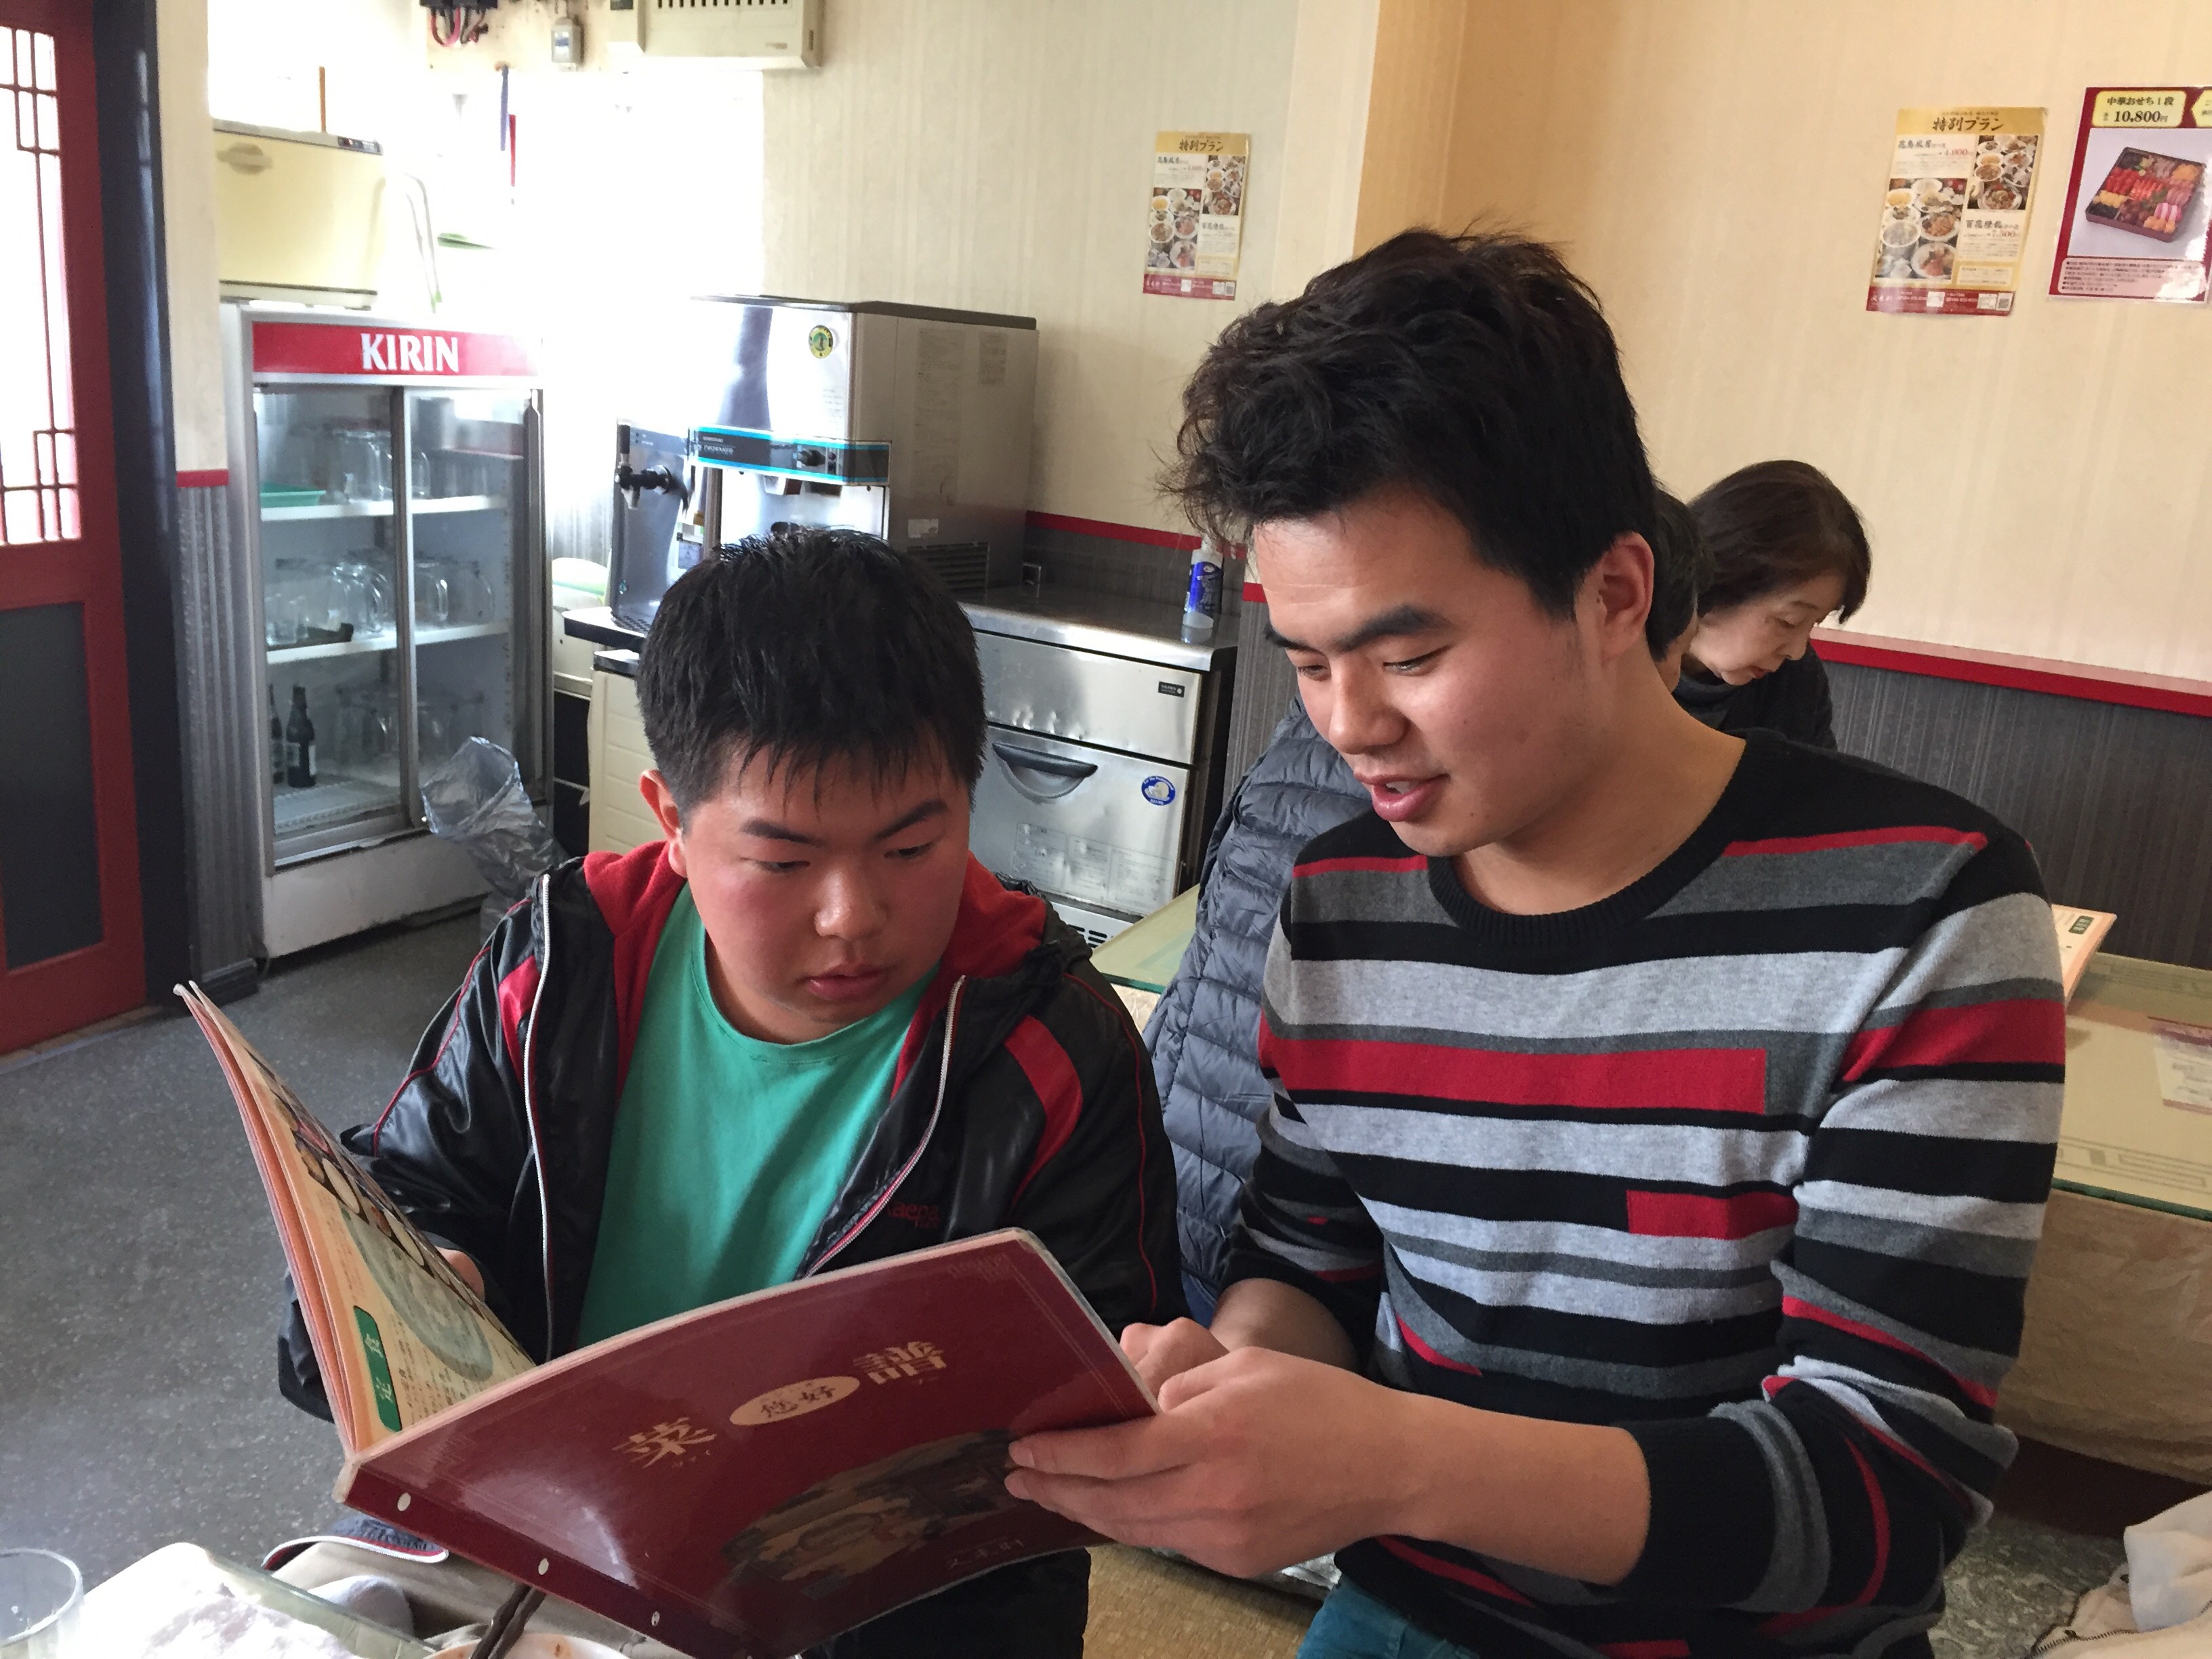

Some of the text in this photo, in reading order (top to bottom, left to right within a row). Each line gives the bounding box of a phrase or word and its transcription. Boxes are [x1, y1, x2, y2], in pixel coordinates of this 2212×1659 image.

[1932, 117, 2003, 131] 特別プラン
[1179, 139, 1223, 152] 特別プラン
[361, 333, 459, 373] KIRIN
[612, 1417, 717, 1469] 菜
